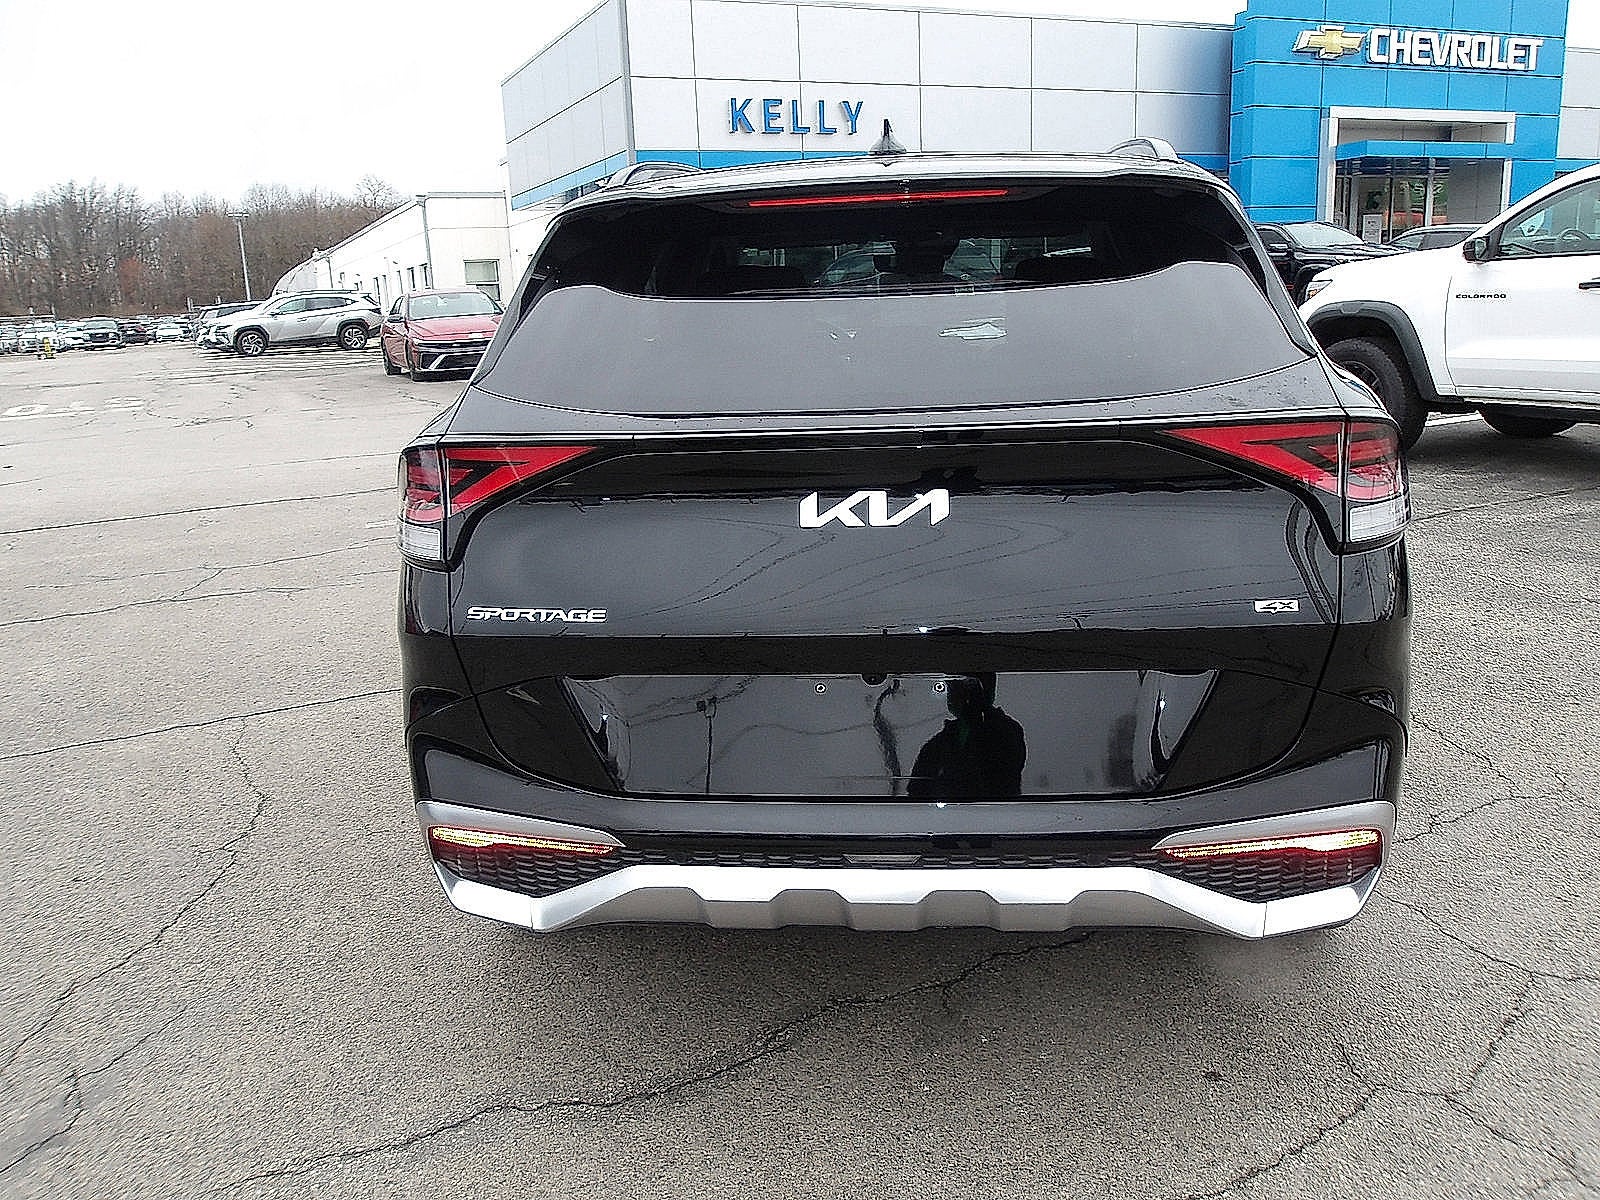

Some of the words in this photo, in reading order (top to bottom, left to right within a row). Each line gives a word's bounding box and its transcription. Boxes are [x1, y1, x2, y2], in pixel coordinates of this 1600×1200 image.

[1366, 27, 1545, 72] CHEVROLET
[729, 97, 864, 135] KELLY
[799, 490, 950, 528] KIA
[466, 606, 607, 623] SPORTAGE
